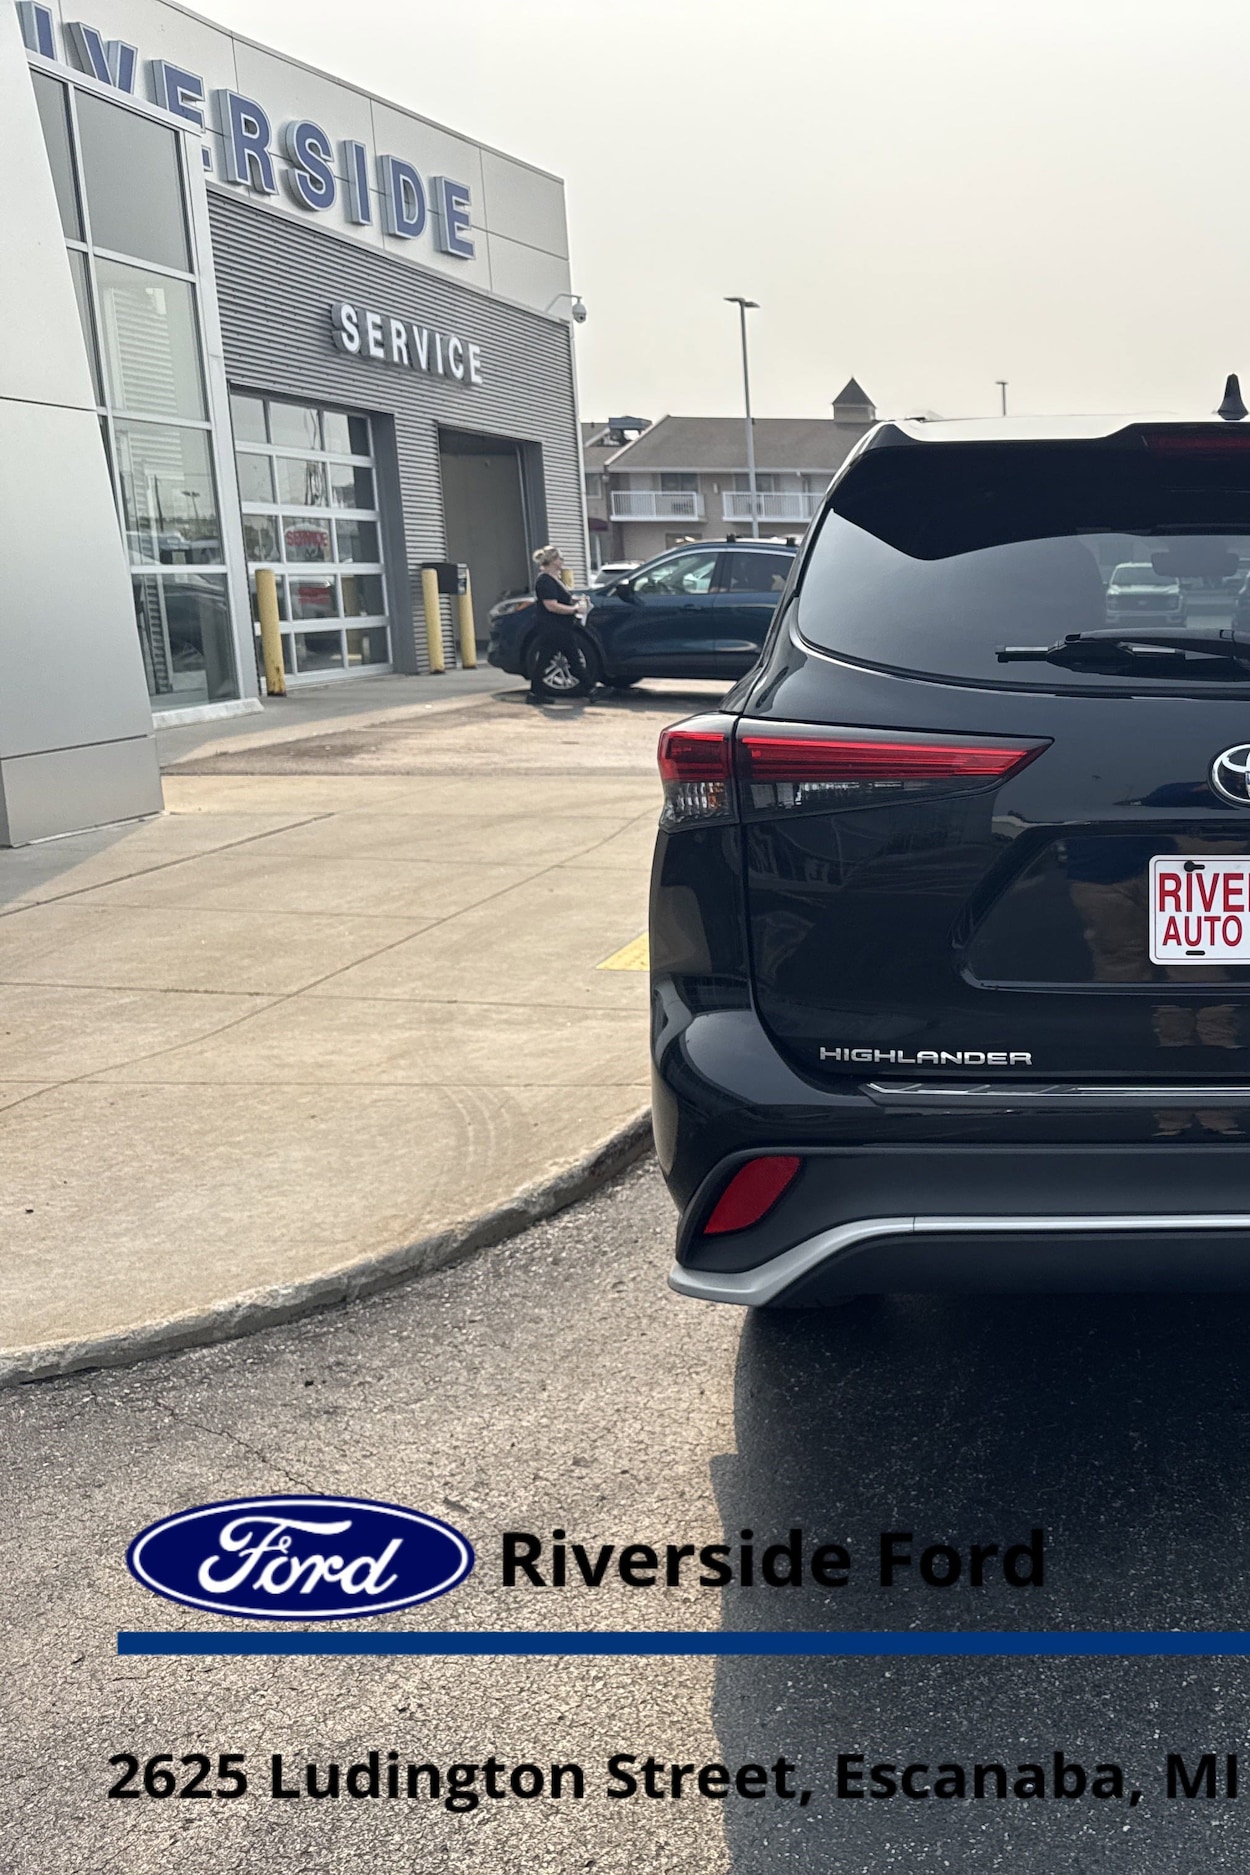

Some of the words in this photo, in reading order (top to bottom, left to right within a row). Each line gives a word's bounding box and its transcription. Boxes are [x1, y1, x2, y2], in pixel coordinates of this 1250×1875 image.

[333, 303, 484, 386] SERVICE
[1162, 914, 1243, 947] AUTO
[819, 1046, 1033, 1066] HIGHLANDER
